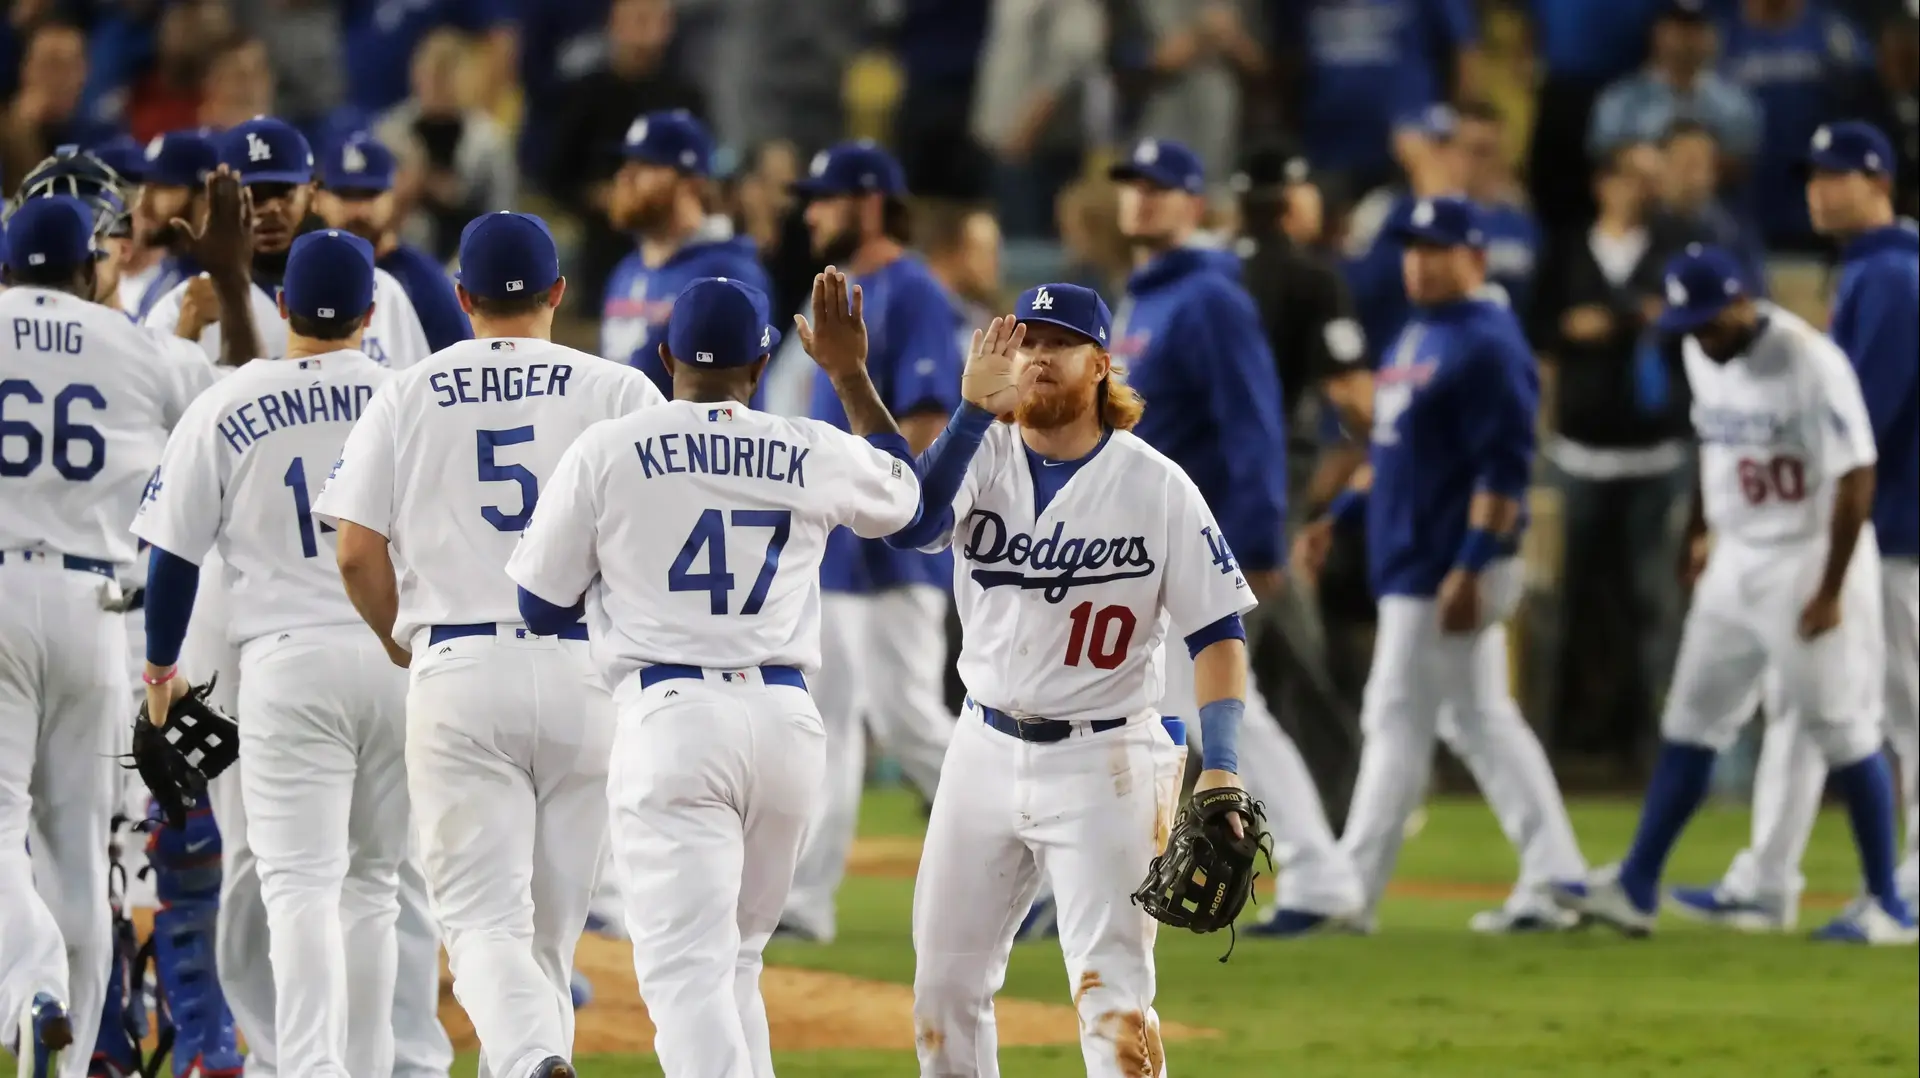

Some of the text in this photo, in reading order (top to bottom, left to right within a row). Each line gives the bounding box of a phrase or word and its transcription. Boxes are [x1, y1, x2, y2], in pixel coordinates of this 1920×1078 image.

[246, 132, 272, 162] LA
[1032, 286, 1054, 311] LA
[13, 317, 83, 355] PUIG
[429, 364, 573, 407] SEAGER
[0, 378, 107, 482] 66
[476, 424, 539, 532] 5
[634, 433, 810, 488] KENDRICK
[1737, 455, 1806, 507] 60
[668, 508, 791, 615] 47
[964, 509, 1155, 604] Dodgers
[1064, 601, 1137, 670] 10
[1209, 882, 1226, 916] A2000
